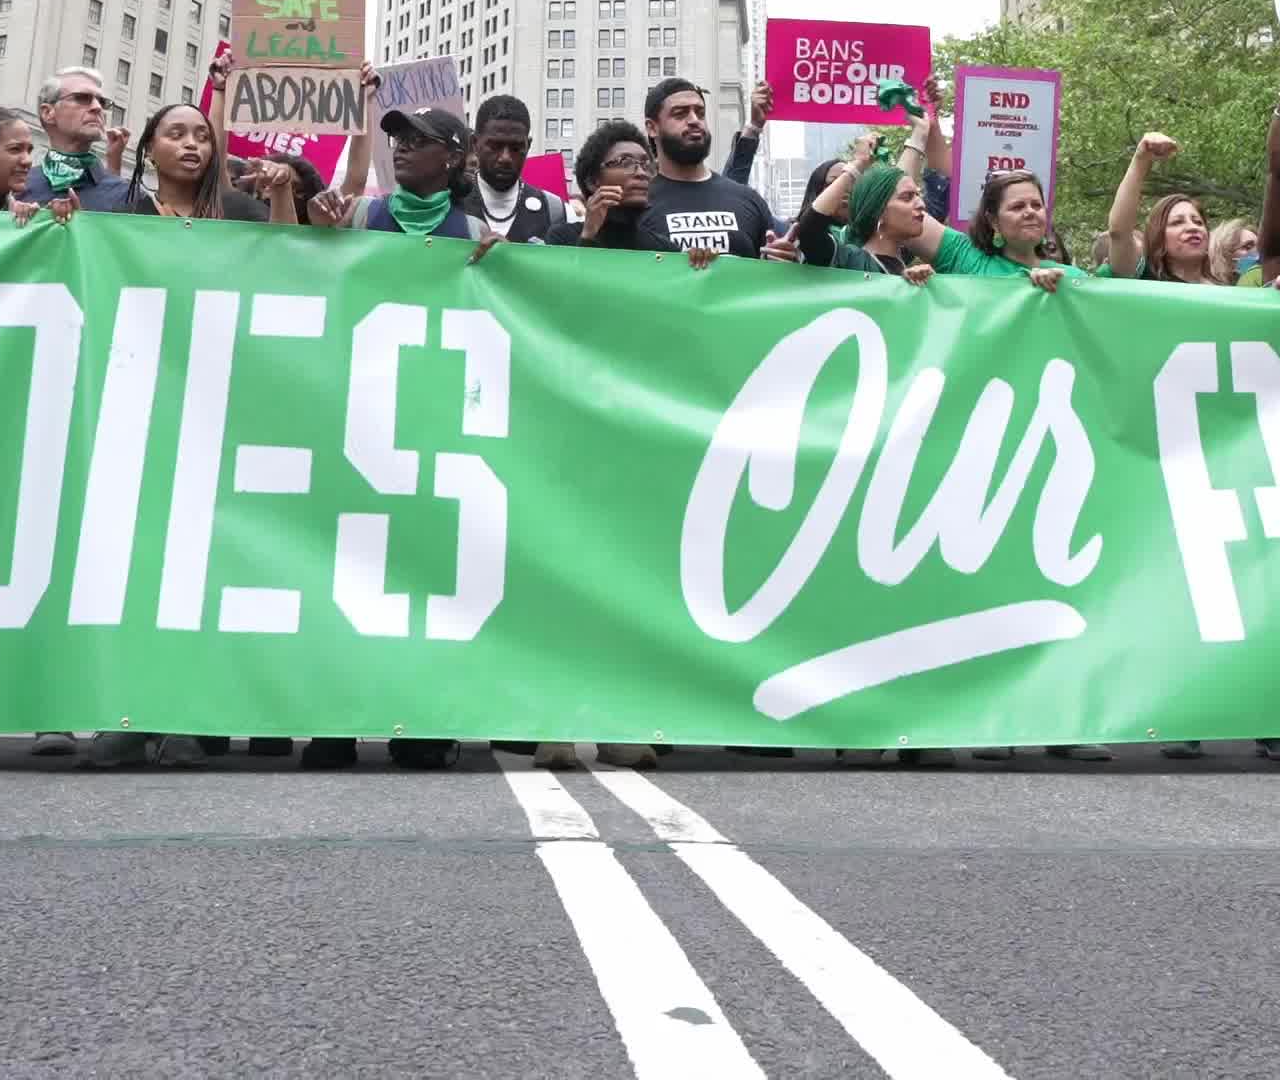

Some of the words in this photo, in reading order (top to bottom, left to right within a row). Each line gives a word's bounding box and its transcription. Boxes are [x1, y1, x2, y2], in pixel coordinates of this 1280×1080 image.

[247, 31, 345, 62] LEGAL
[795, 37, 864, 61] BANS
[793, 60, 843, 82] OFF
[846, 62, 905, 83] OUR
[230, 72, 365, 130] ABORION
[794, 82, 878, 106] BODIE
[990, 92, 1030, 109] END
[987, 156, 1026, 171] FOR
[670, 214, 734, 229] STAND
[673, 236, 726, 250] WITH
[680, 307, 1104, 643] Our
